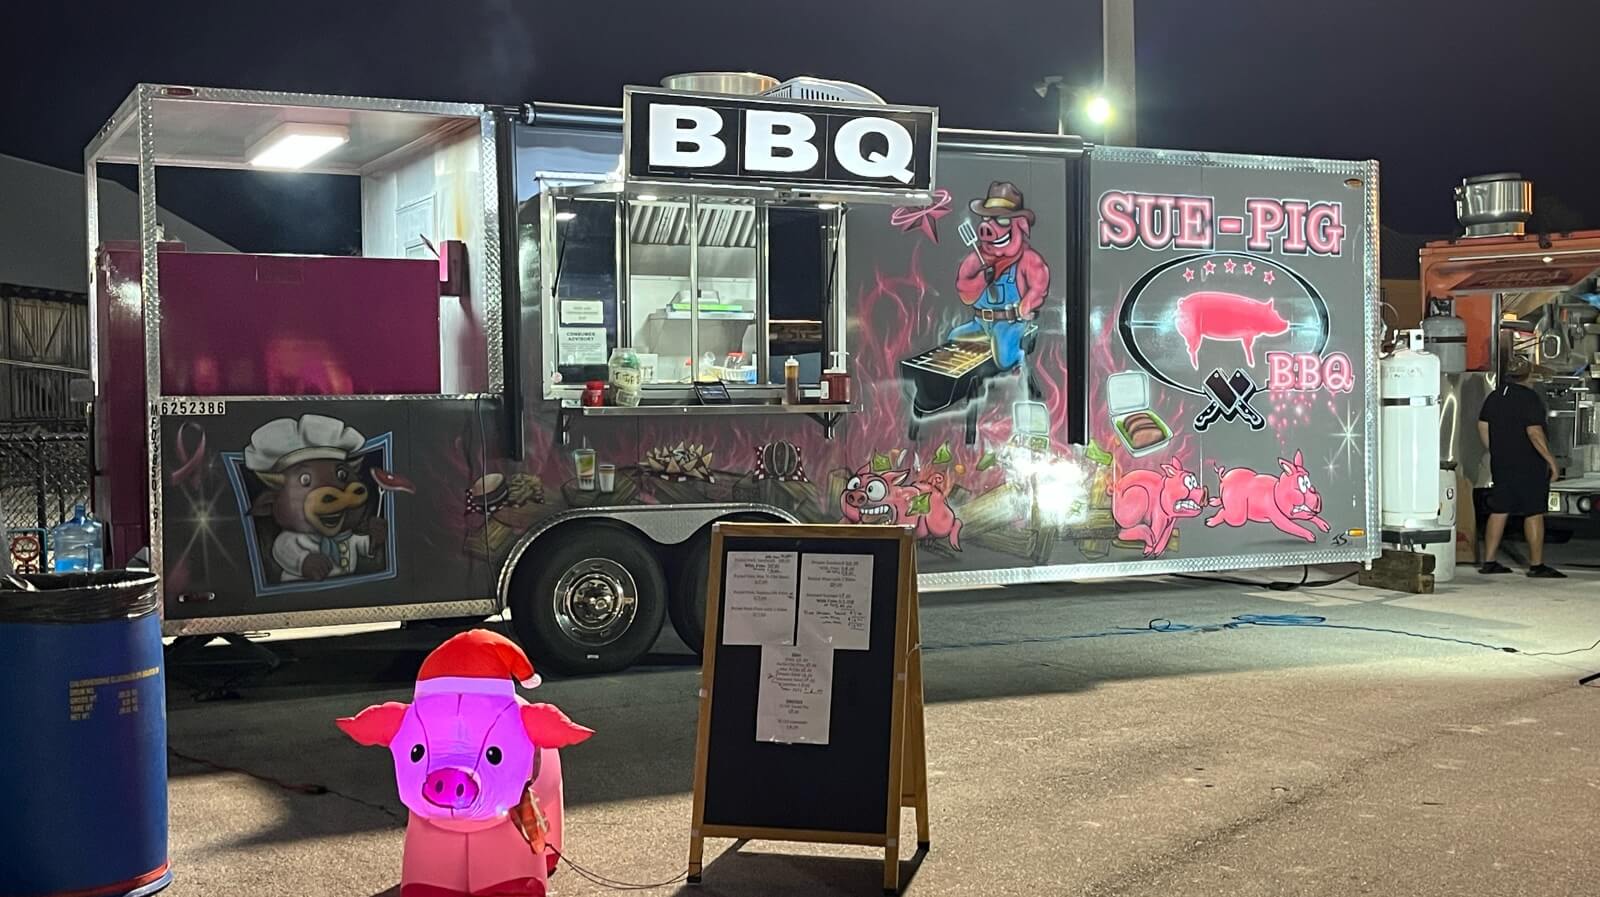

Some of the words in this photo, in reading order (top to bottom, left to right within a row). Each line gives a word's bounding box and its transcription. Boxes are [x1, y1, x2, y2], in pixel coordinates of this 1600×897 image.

[649, 103, 914, 184] BBQ
[1099, 190, 1346, 256] SUE-PIG
[1265, 351, 1354, 393] BBQ
[161, 402, 224, 415] 6252386
